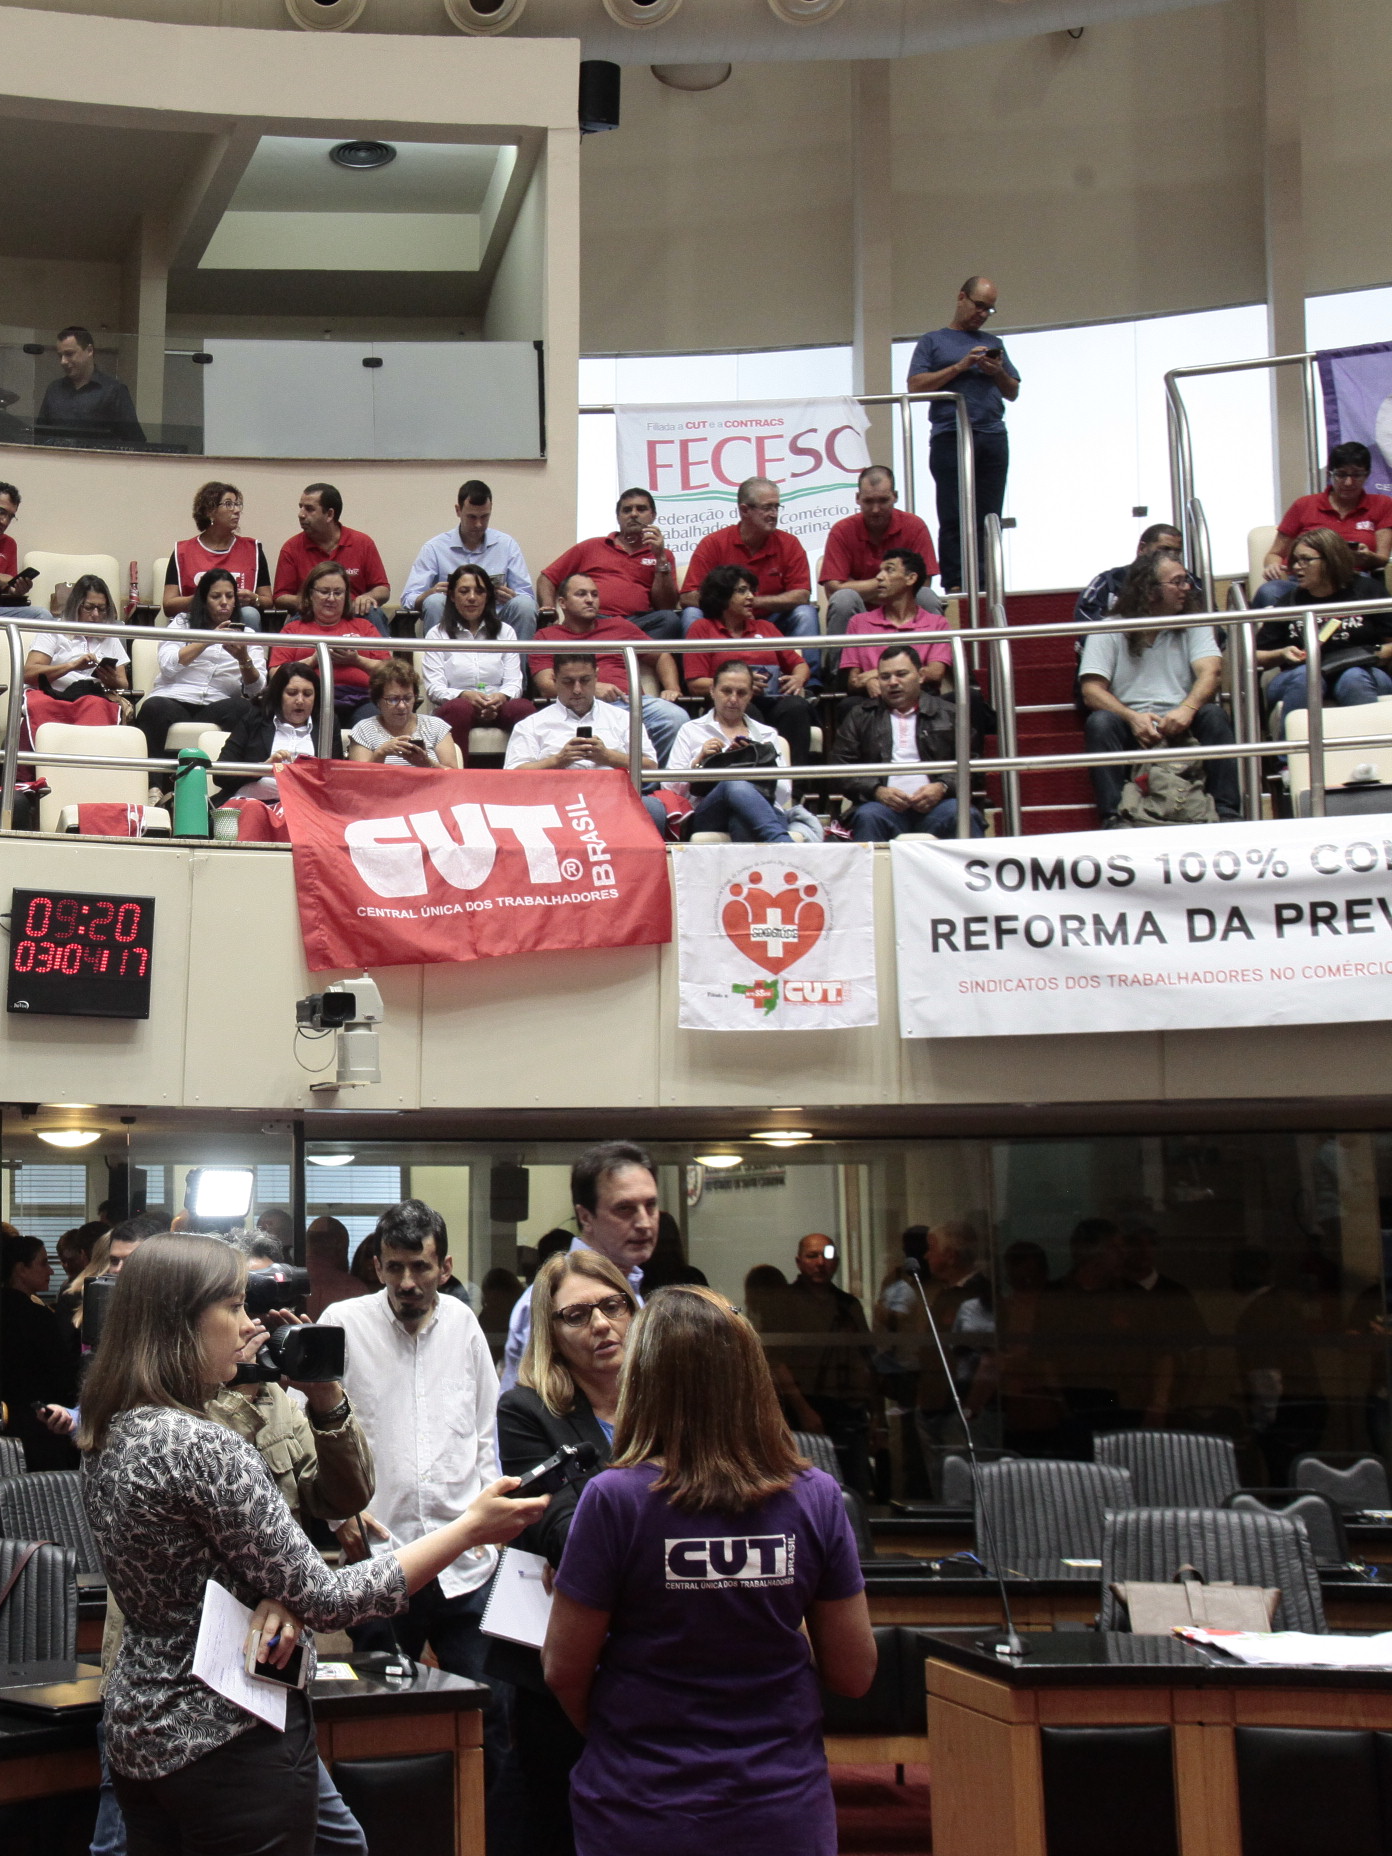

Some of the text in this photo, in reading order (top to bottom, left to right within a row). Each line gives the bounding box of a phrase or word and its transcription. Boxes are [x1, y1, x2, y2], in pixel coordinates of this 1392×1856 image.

[685, 420, 708, 430] CUT
[724, 418, 784, 429] CONTRACS
[646, 425, 866, 492] FECESC
[656, 508, 724, 526] ederação
[344, 803, 563, 898] CUT
[565, 793, 616, 887] BRASIL
[963, 853, 1137, 893] SOMOS
[1154, 847, 1290, 884] 100%
[25, 897, 141, 942] 09:20
[356, 888, 619, 920] CENTRAL ÚNICA DOS TRABALHADORES
[930, 910, 1168, 954] REFORMA
[1185, 905, 1256, 944] DA
[958, 976, 1059, 994] SINDICATOS
[1065, 974, 1101, 990] DOS
[1107, 968, 1264, 988] TRABALHADORES
[1269, 965, 1296, 981] NO
[668, 1536, 785, 1578] CUT
[787, 1533, 796, 1576] BRASIL
[665, 1582, 699, 1590] CENTRAL
[700, 1580, 723, 1590] ÚNICA
[740, 1577, 795, 1588] TRABALHADORES
